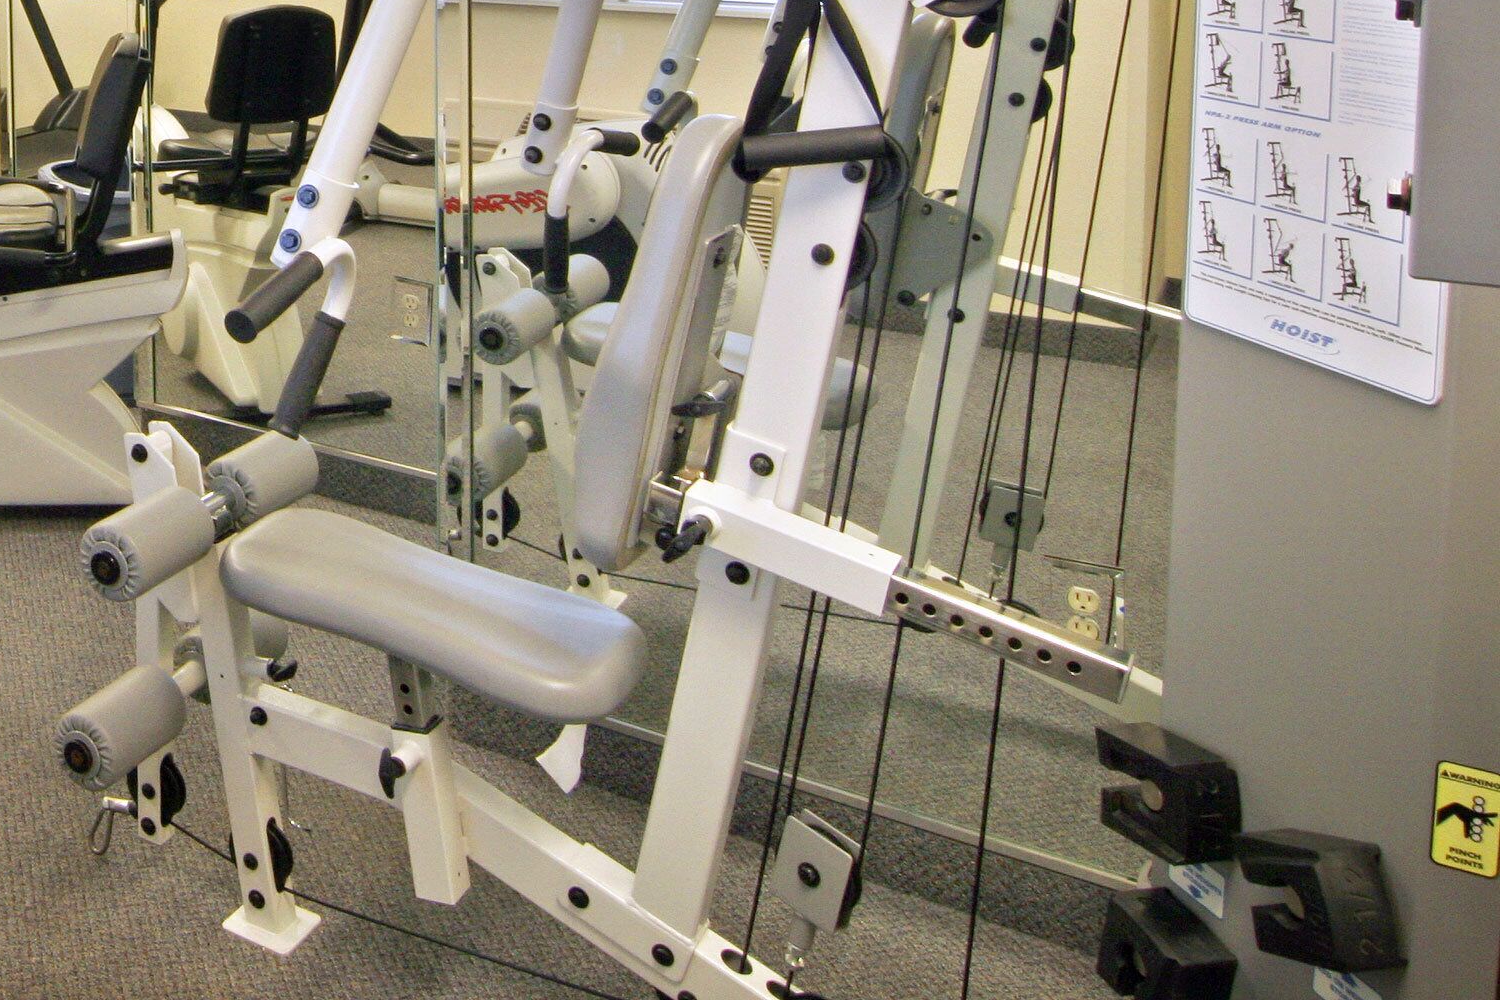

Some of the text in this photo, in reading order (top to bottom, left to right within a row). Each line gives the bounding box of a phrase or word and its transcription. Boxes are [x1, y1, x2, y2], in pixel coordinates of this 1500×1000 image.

[1270, 318, 1335, 348] HOIST
[1445, 853, 1484, 870] POINTS
[1448, 846, 1482, 861] PINCH
